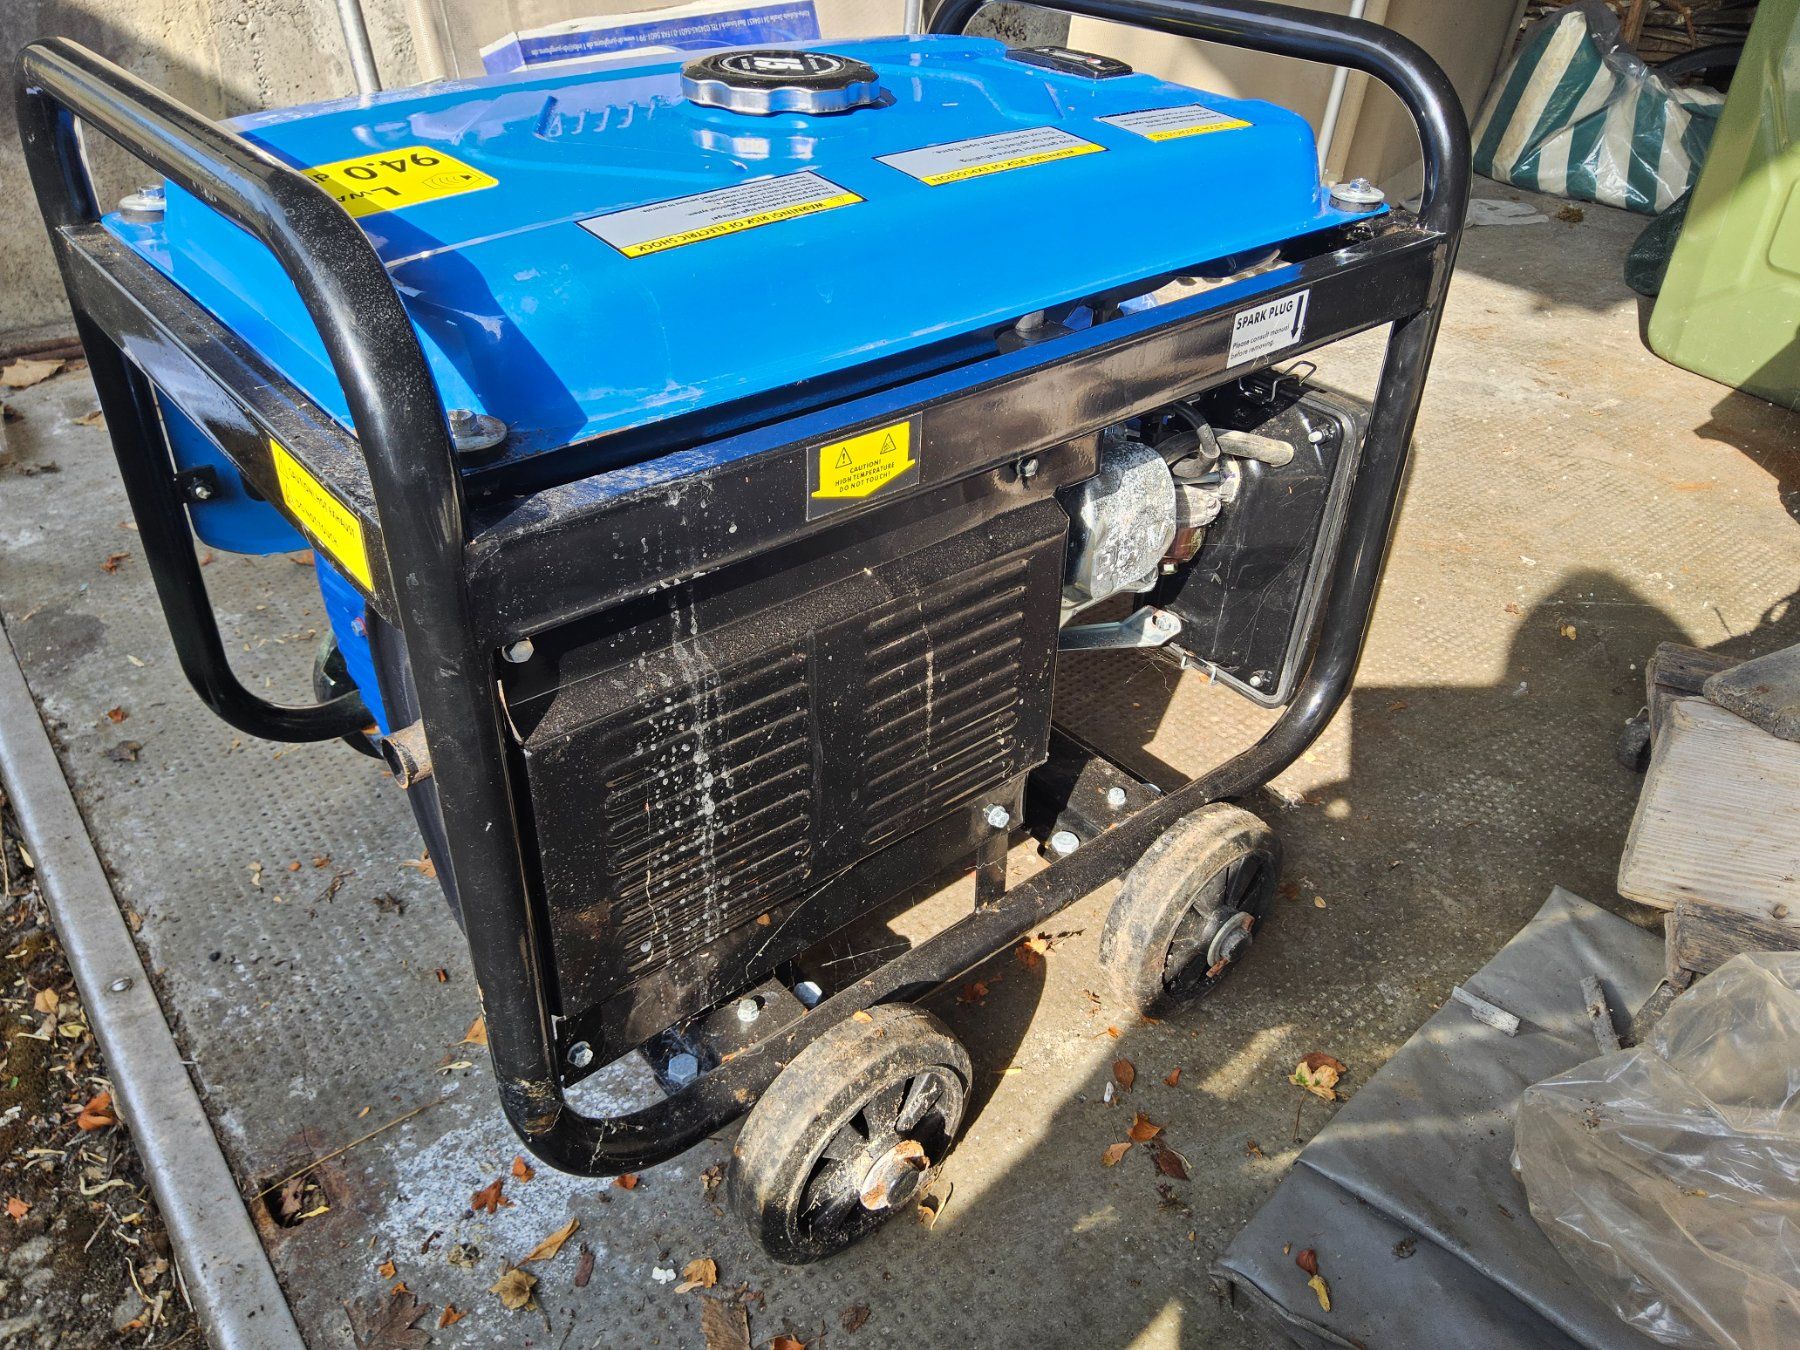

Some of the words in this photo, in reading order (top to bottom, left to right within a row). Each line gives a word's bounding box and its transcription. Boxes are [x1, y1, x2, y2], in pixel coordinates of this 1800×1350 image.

[343, 153, 440, 180] 94.0
[309, 173, 331, 183] d
[766, 201, 827, 218] WARNING!
[723, 221, 745, 229] OF
[742, 214, 771, 224] RISK
[676, 225, 729, 240] ELECTRIC
[633, 236, 680, 251] SHOCK
[1235, 308, 1267, 330] SPARK
[1268, 299, 1293, 319] PLUG
[1231, 337, 1250, 350] Please
[1250, 330, 1269, 343] consult
[1269, 322, 1290, 336] manual
[1230, 346, 1248, 360] before
[834, 475, 851, 486] HIGH
[853, 461, 894, 480] TEMPERATURE
[849, 458, 881, 474] CAUTION!
[839, 484, 848, 492] DO
[850, 479, 864, 489] NOT
[866, 470, 890, 484] TOUCH!
